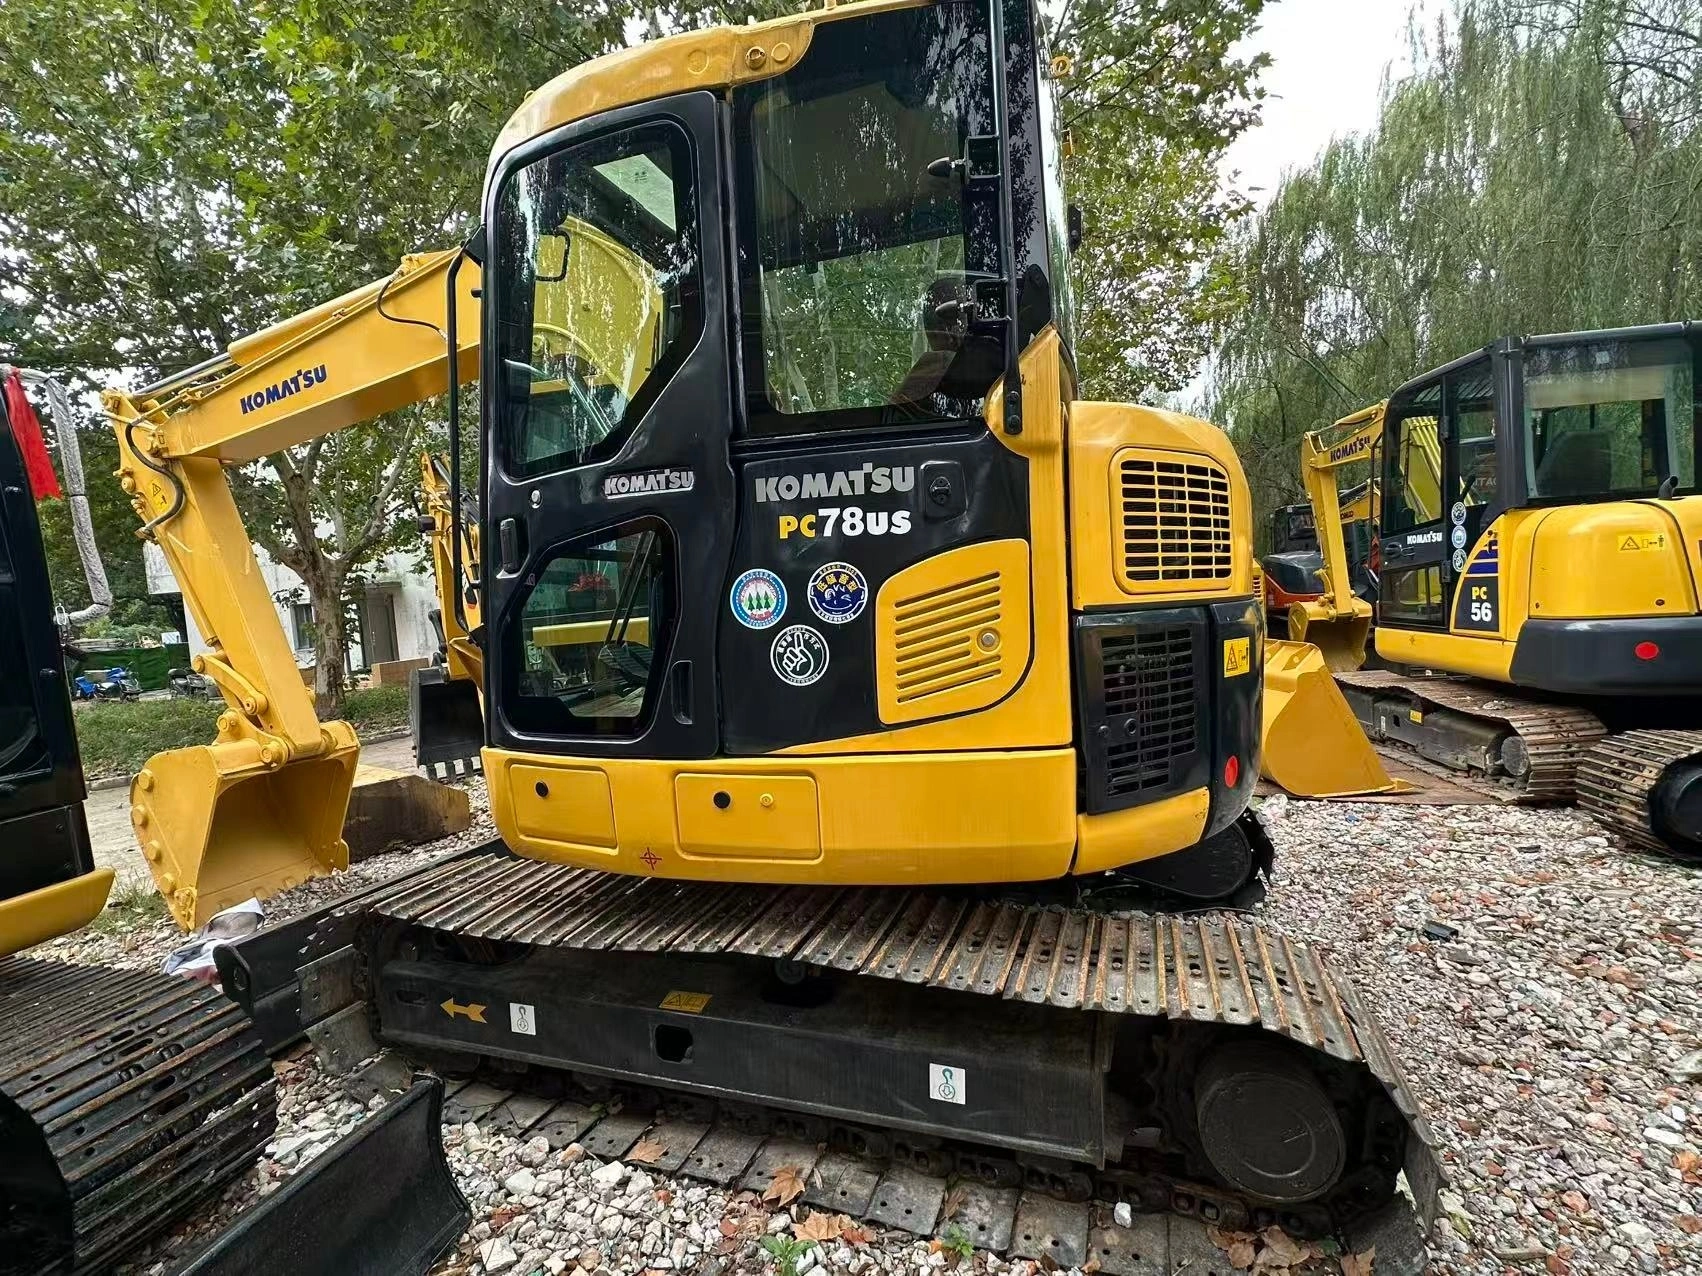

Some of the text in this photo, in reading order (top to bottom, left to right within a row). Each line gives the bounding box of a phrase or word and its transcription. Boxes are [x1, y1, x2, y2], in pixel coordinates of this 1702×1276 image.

[240, 364, 327, 414] KOMATSU
[604, 468, 694, 495] KOMATSU
[754, 462, 915, 503] KOMATSU
[1407, 530, 1443, 545] KOMATSU
[1471, 586, 1488, 600] PC
[1470, 602, 1493, 622] 56
